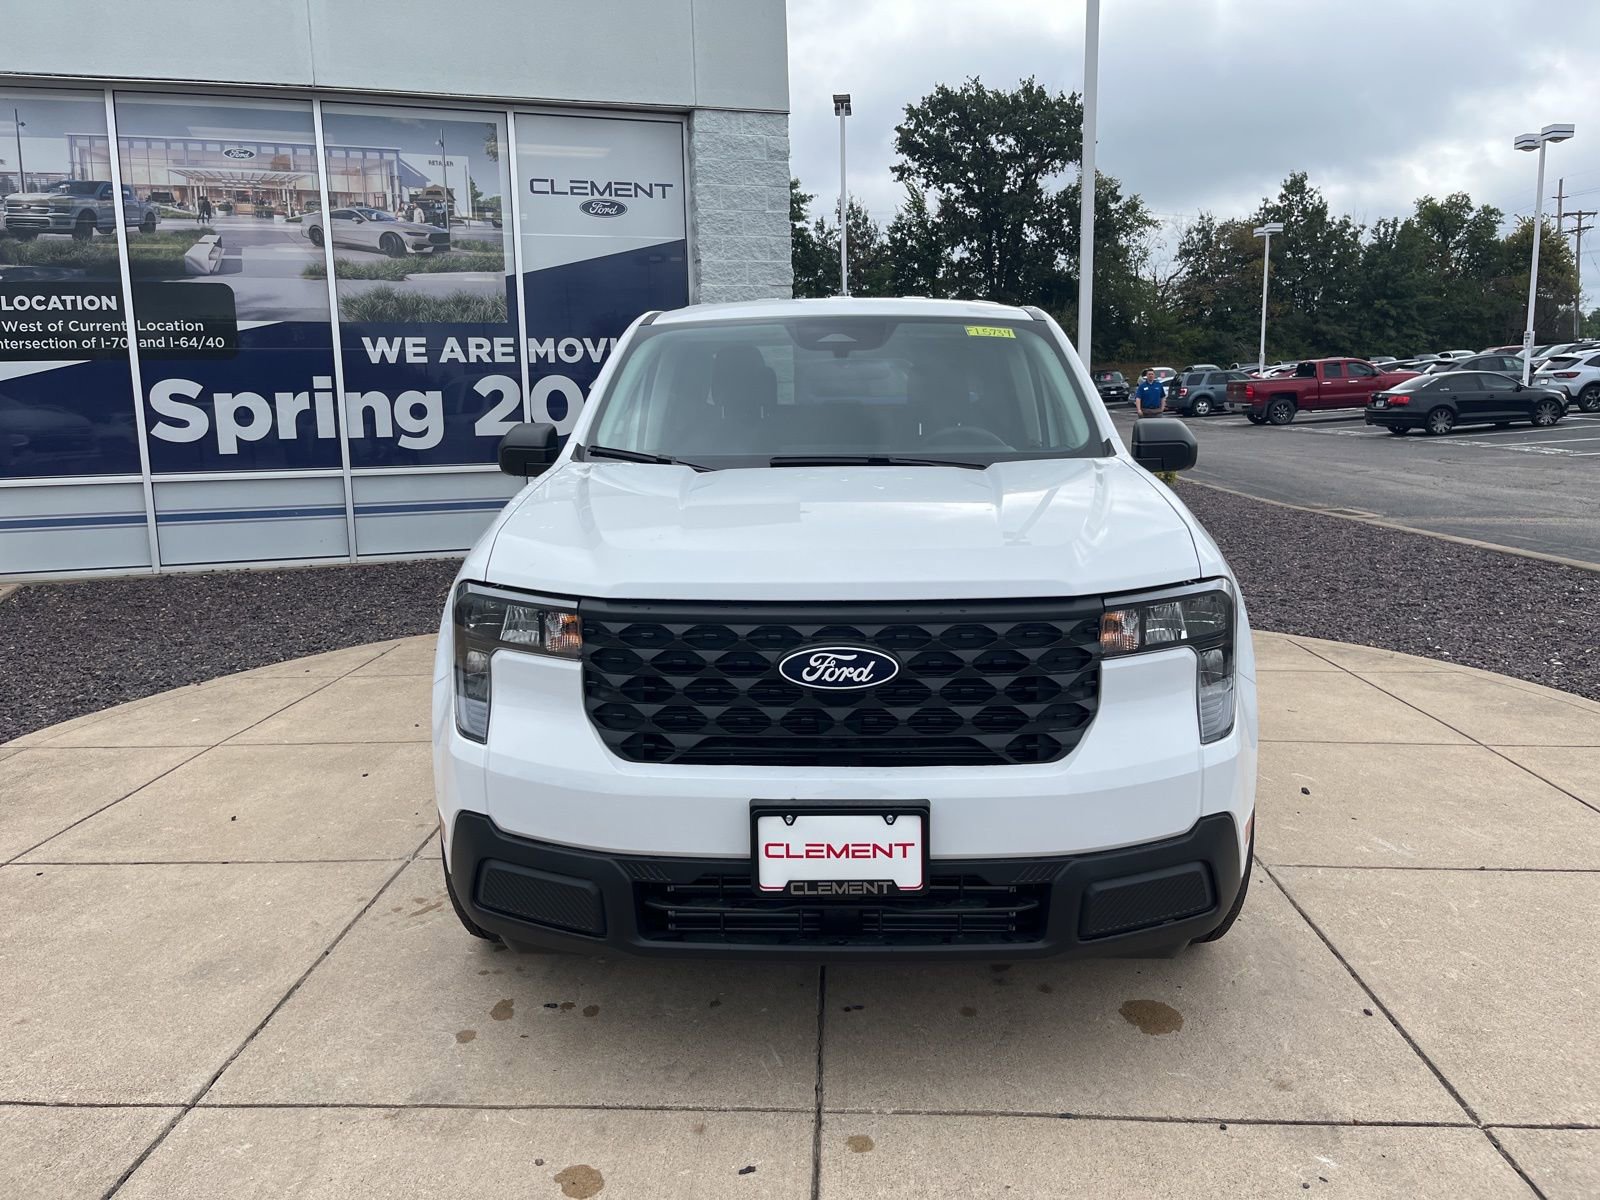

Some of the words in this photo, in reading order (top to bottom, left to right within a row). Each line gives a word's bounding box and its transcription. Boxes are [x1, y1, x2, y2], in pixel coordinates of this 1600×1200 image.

[529, 178, 674, 199] CLEMENT
[589, 201, 618, 215] Ford
[1, 295, 118, 311] LOCATION
[2, 321, 43, 332] West
[47, 320, 63, 332] of
[68, 320, 128, 332] Current
[137, 319, 204, 331] Location
[81, 337, 97, 349] of
[101, 337, 129, 349] I-70
[139, 336, 165, 348] and
[170, 336, 225, 350] I-64/40
[361, 336, 428, 364] WE
[439, 336, 515, 363] ARE
[149, 375, 445, 455] Spring
[473, 374, 597, 437] 20
[802, 653, 874, 682] Ford
[764, 842, 915, 859] CLEMENT
[790, 881, 893, 895] CLEMENT
